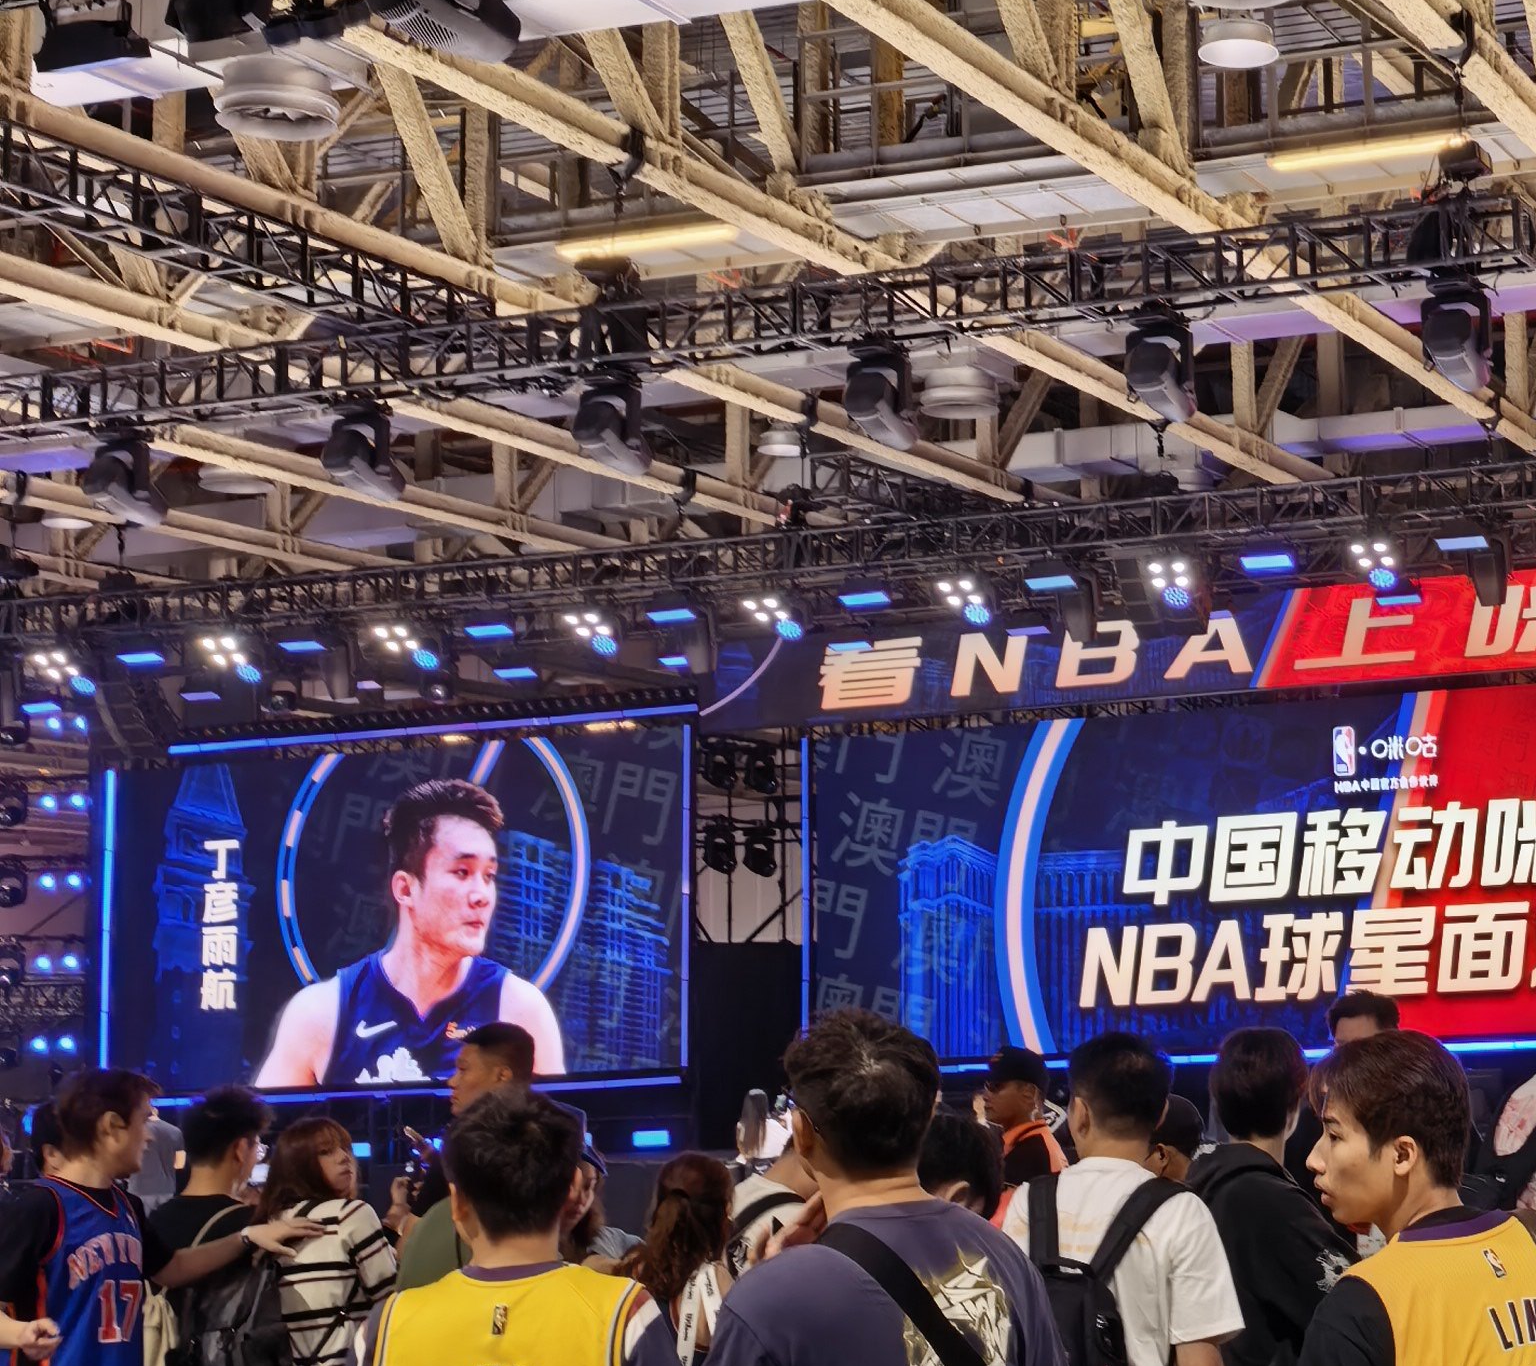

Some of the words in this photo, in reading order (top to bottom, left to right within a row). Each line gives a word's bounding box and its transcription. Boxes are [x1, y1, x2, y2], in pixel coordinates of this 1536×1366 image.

[200, 839, 240, 1011] 丁彦雨航
[98, 1279, 143, 1344] 17
